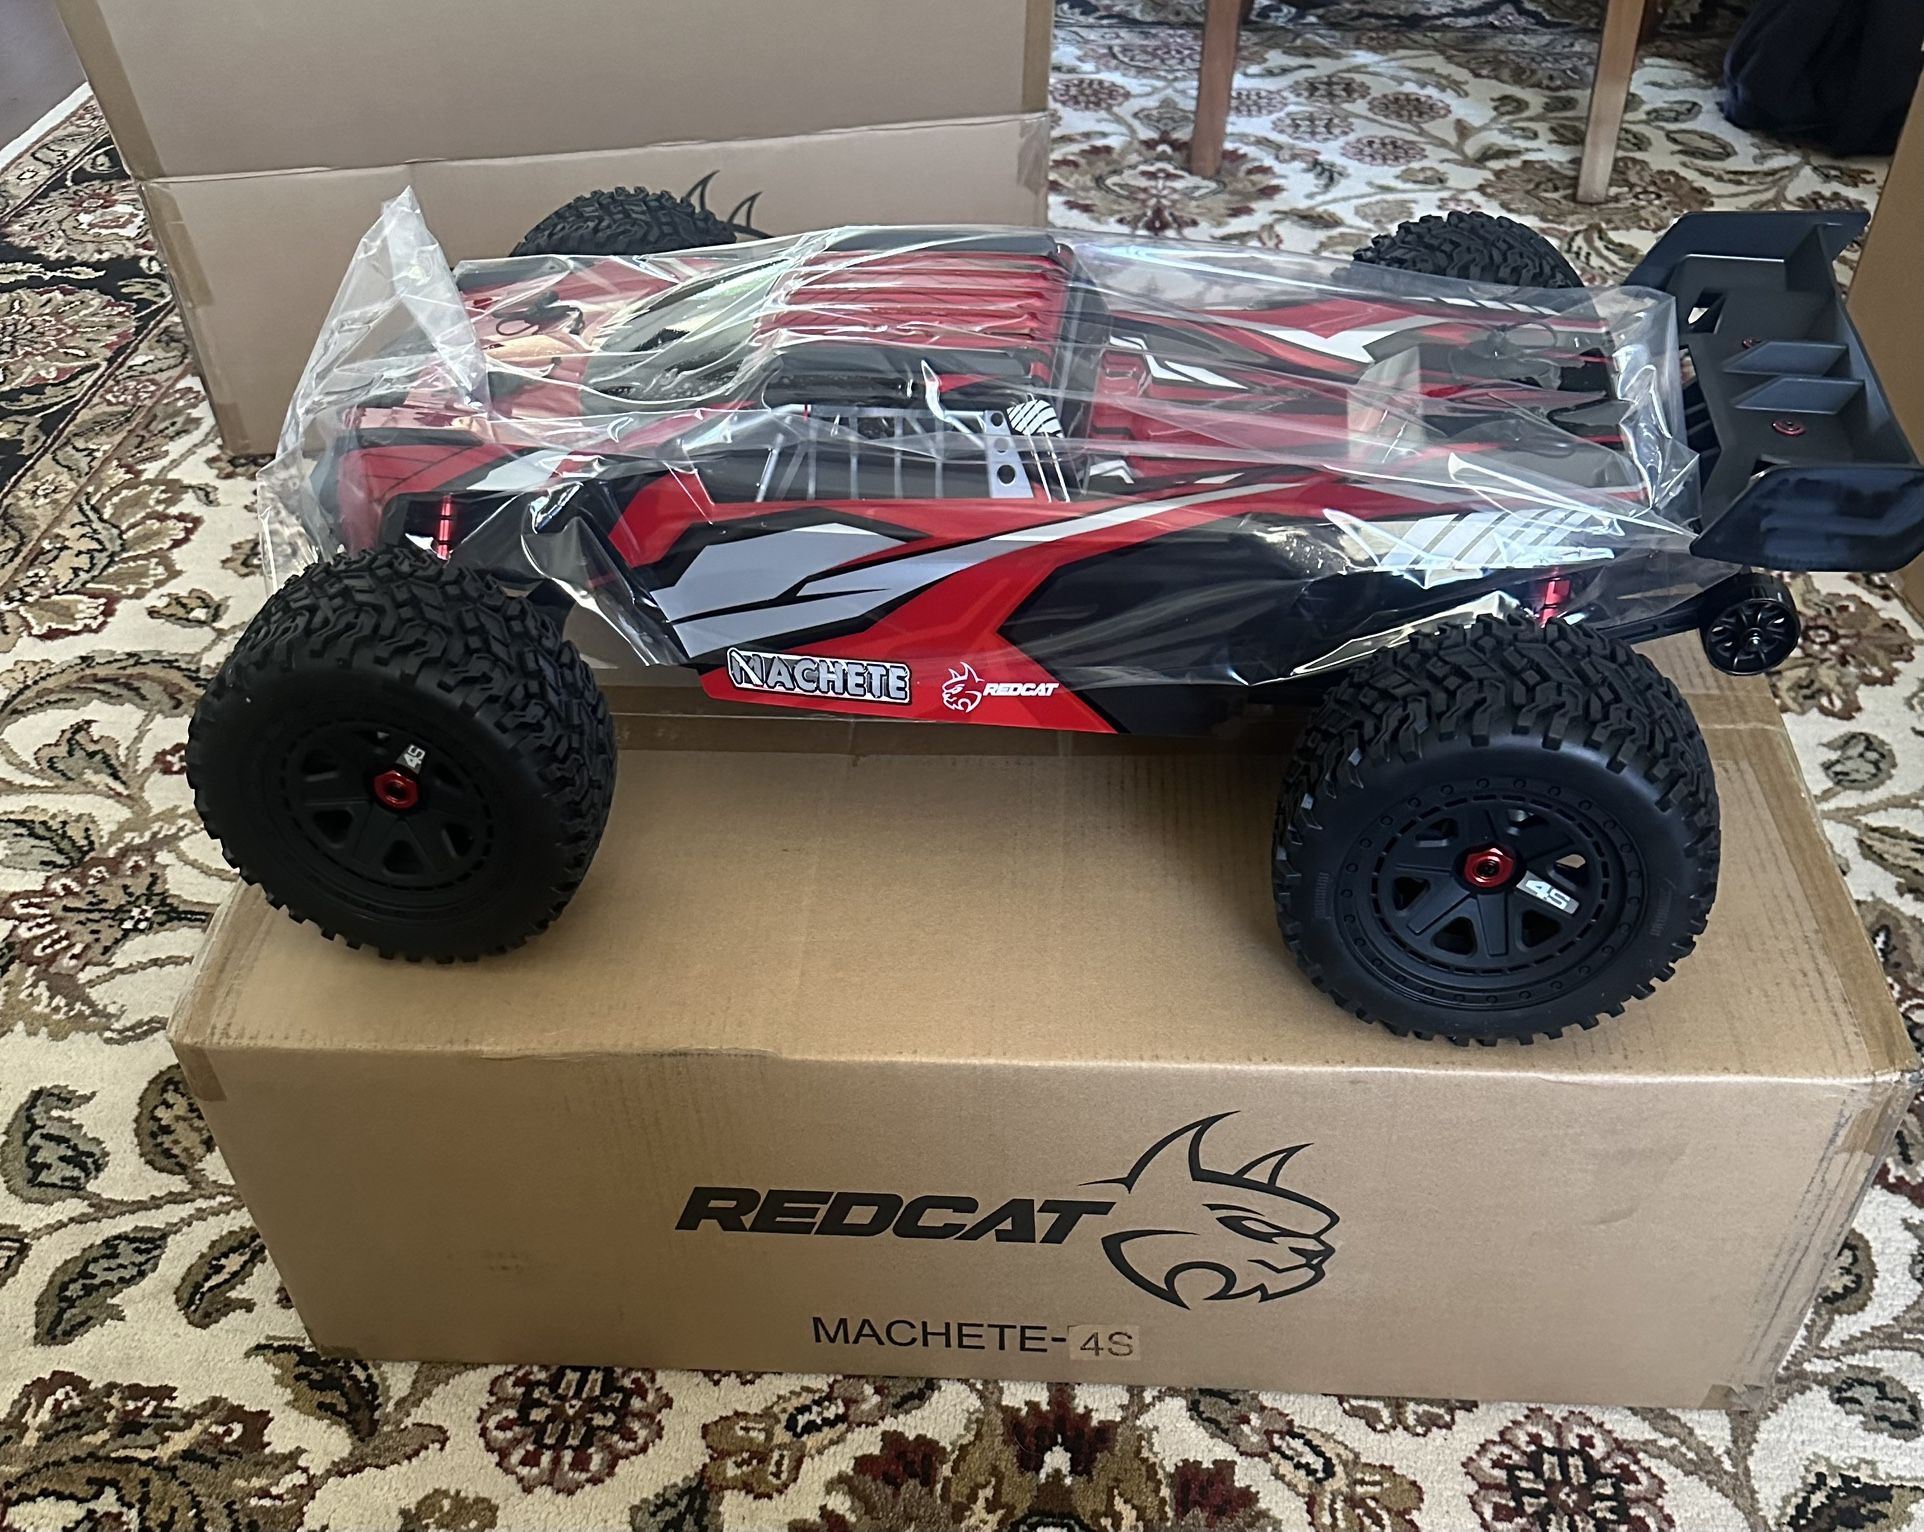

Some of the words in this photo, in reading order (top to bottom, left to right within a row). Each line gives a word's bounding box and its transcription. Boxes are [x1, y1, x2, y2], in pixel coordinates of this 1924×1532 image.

[729, 651, 908, 701] MACHETE
[983, 682, 1059, 697] REDCAT
[404, 744, 426, 768] 4S
[1525, 879, 1571, 910] 4S
[674, 1186, 1118, 1244] REDCAT
